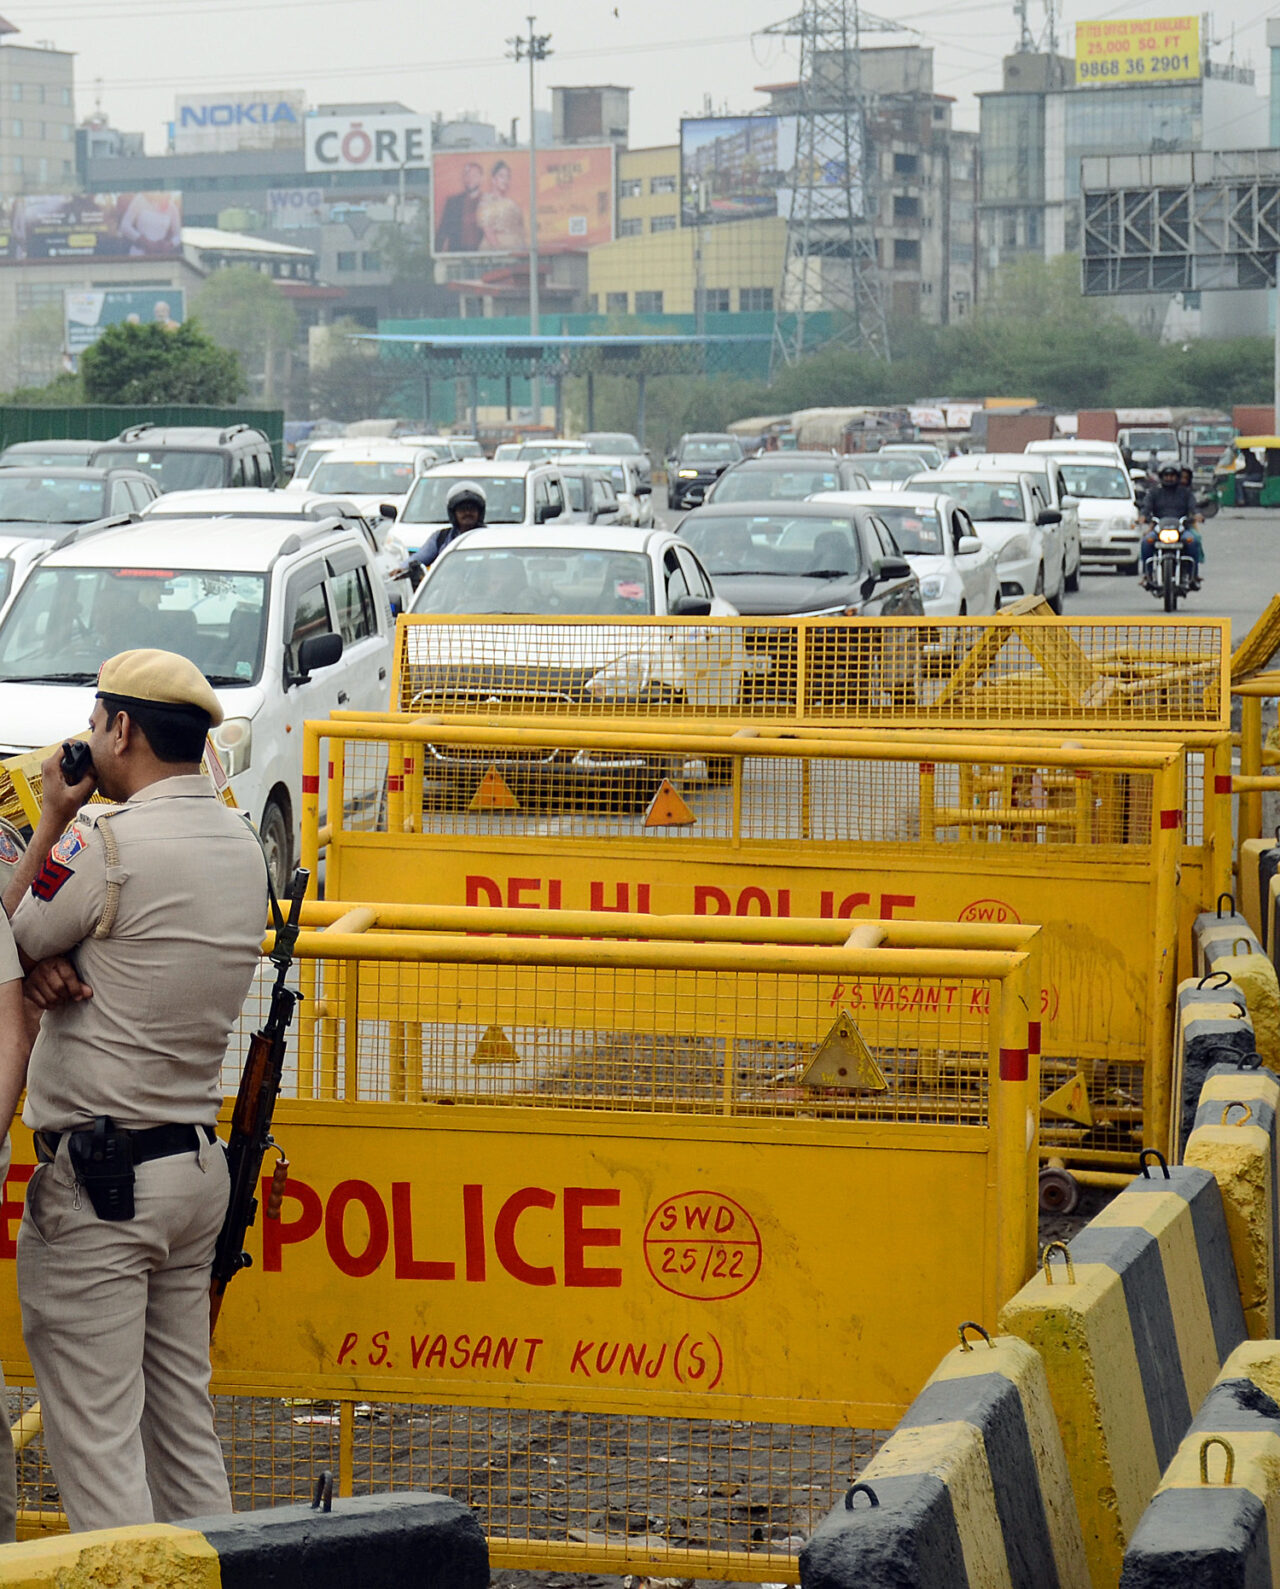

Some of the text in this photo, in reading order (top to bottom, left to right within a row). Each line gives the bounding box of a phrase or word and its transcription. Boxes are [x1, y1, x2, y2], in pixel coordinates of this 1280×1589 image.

[1131, 22, 1151, 34] SPACE
[1154, 18, 1192, 31] AVAILABLE
[1087, 41, 1130, 55] 25,000
[1164, 37, 1180, 48] FT
[1080, 55, 1189, 78] 9868 36 2901
[180, 102, 297, 127] NOKIA
[966, 907, 1007, 922] SWD
[872, 984, 958, 1014] VASANT
[261, 1176, 622, 1287] POLICE
[660, 1205, 735, 1233] SWD
[662, 1245, 744, 1283] 25/22
[410, 1334, 544, 1375] VASANT
